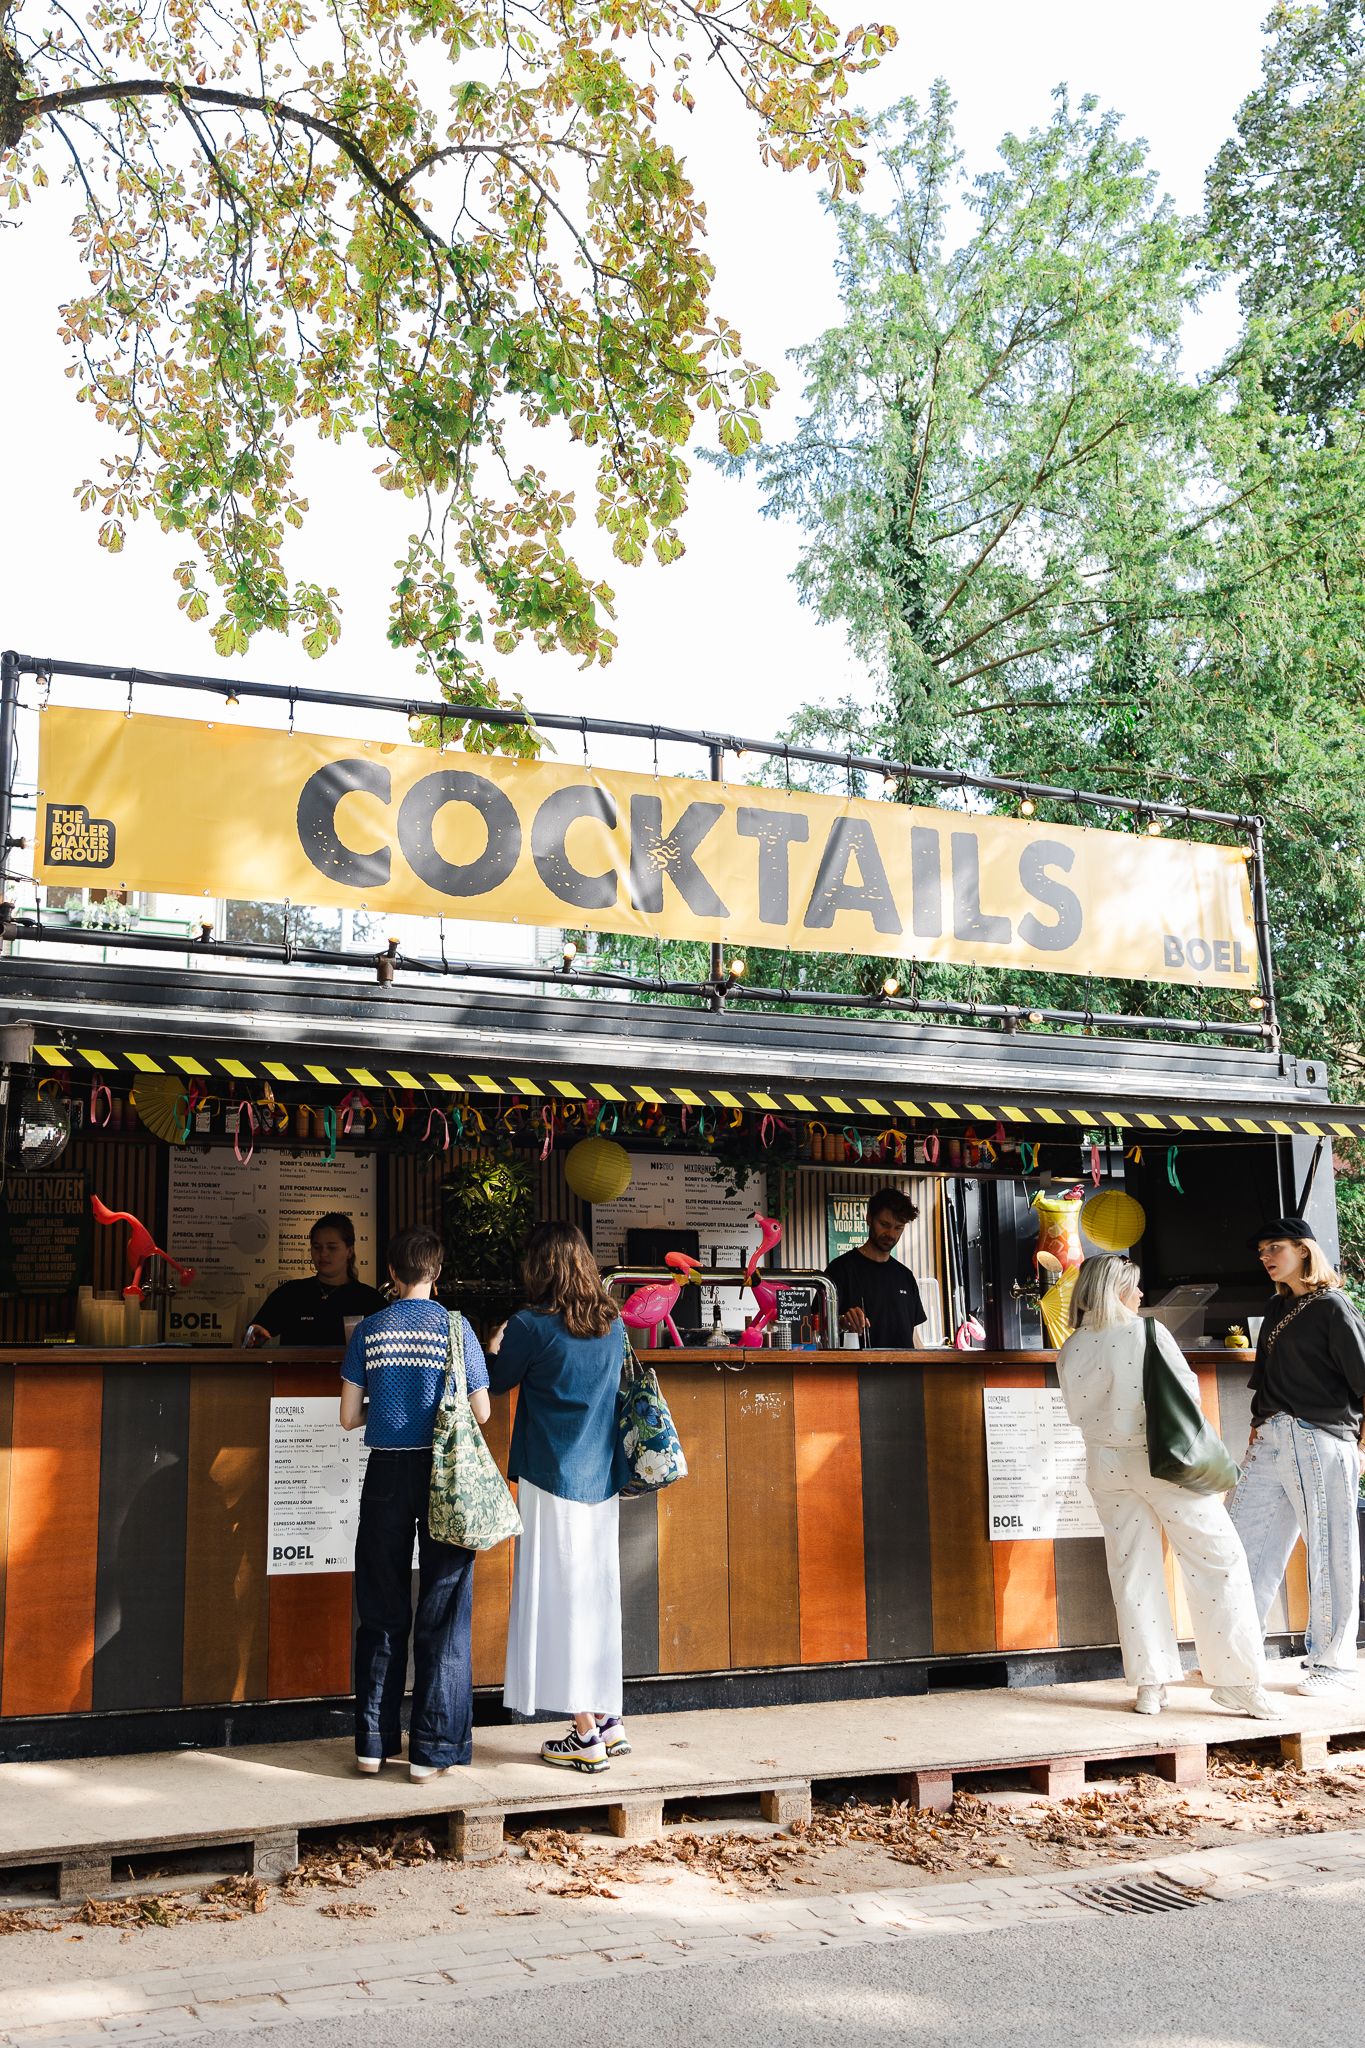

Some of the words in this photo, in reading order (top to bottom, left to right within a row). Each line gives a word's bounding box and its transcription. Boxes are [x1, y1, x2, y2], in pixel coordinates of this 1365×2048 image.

[52, 810, 84, 823] THE
[52, 822, 109, 838] BOILER
[51, 835, 109, 850] MAKER
[50, 847, 109, 863] GROUP
[297, 759, 1082, 950] COCKTAILS
[1164, 935, 1249, 973] BOEL
[7, 1179, 84, 1199] VRIENDEN
[7, 1200, 32, 1214] VOOR
[34, 1200, 53, 1214] HET
[54, 1200, 84, 1214] LEVEN
[833, 1202, 868, 1221] VRIEN
[833, 1220, 853, 1233] VOOR
[854, 1221, 868, 1233] HET
[169, 1312, 222, 1330] BOEL
[275, 1406, 305, 1416] COCKTAILS
[993, 1515, 1024, 1528] BOEL
[272, 1545, 314, 1561] BOEL
